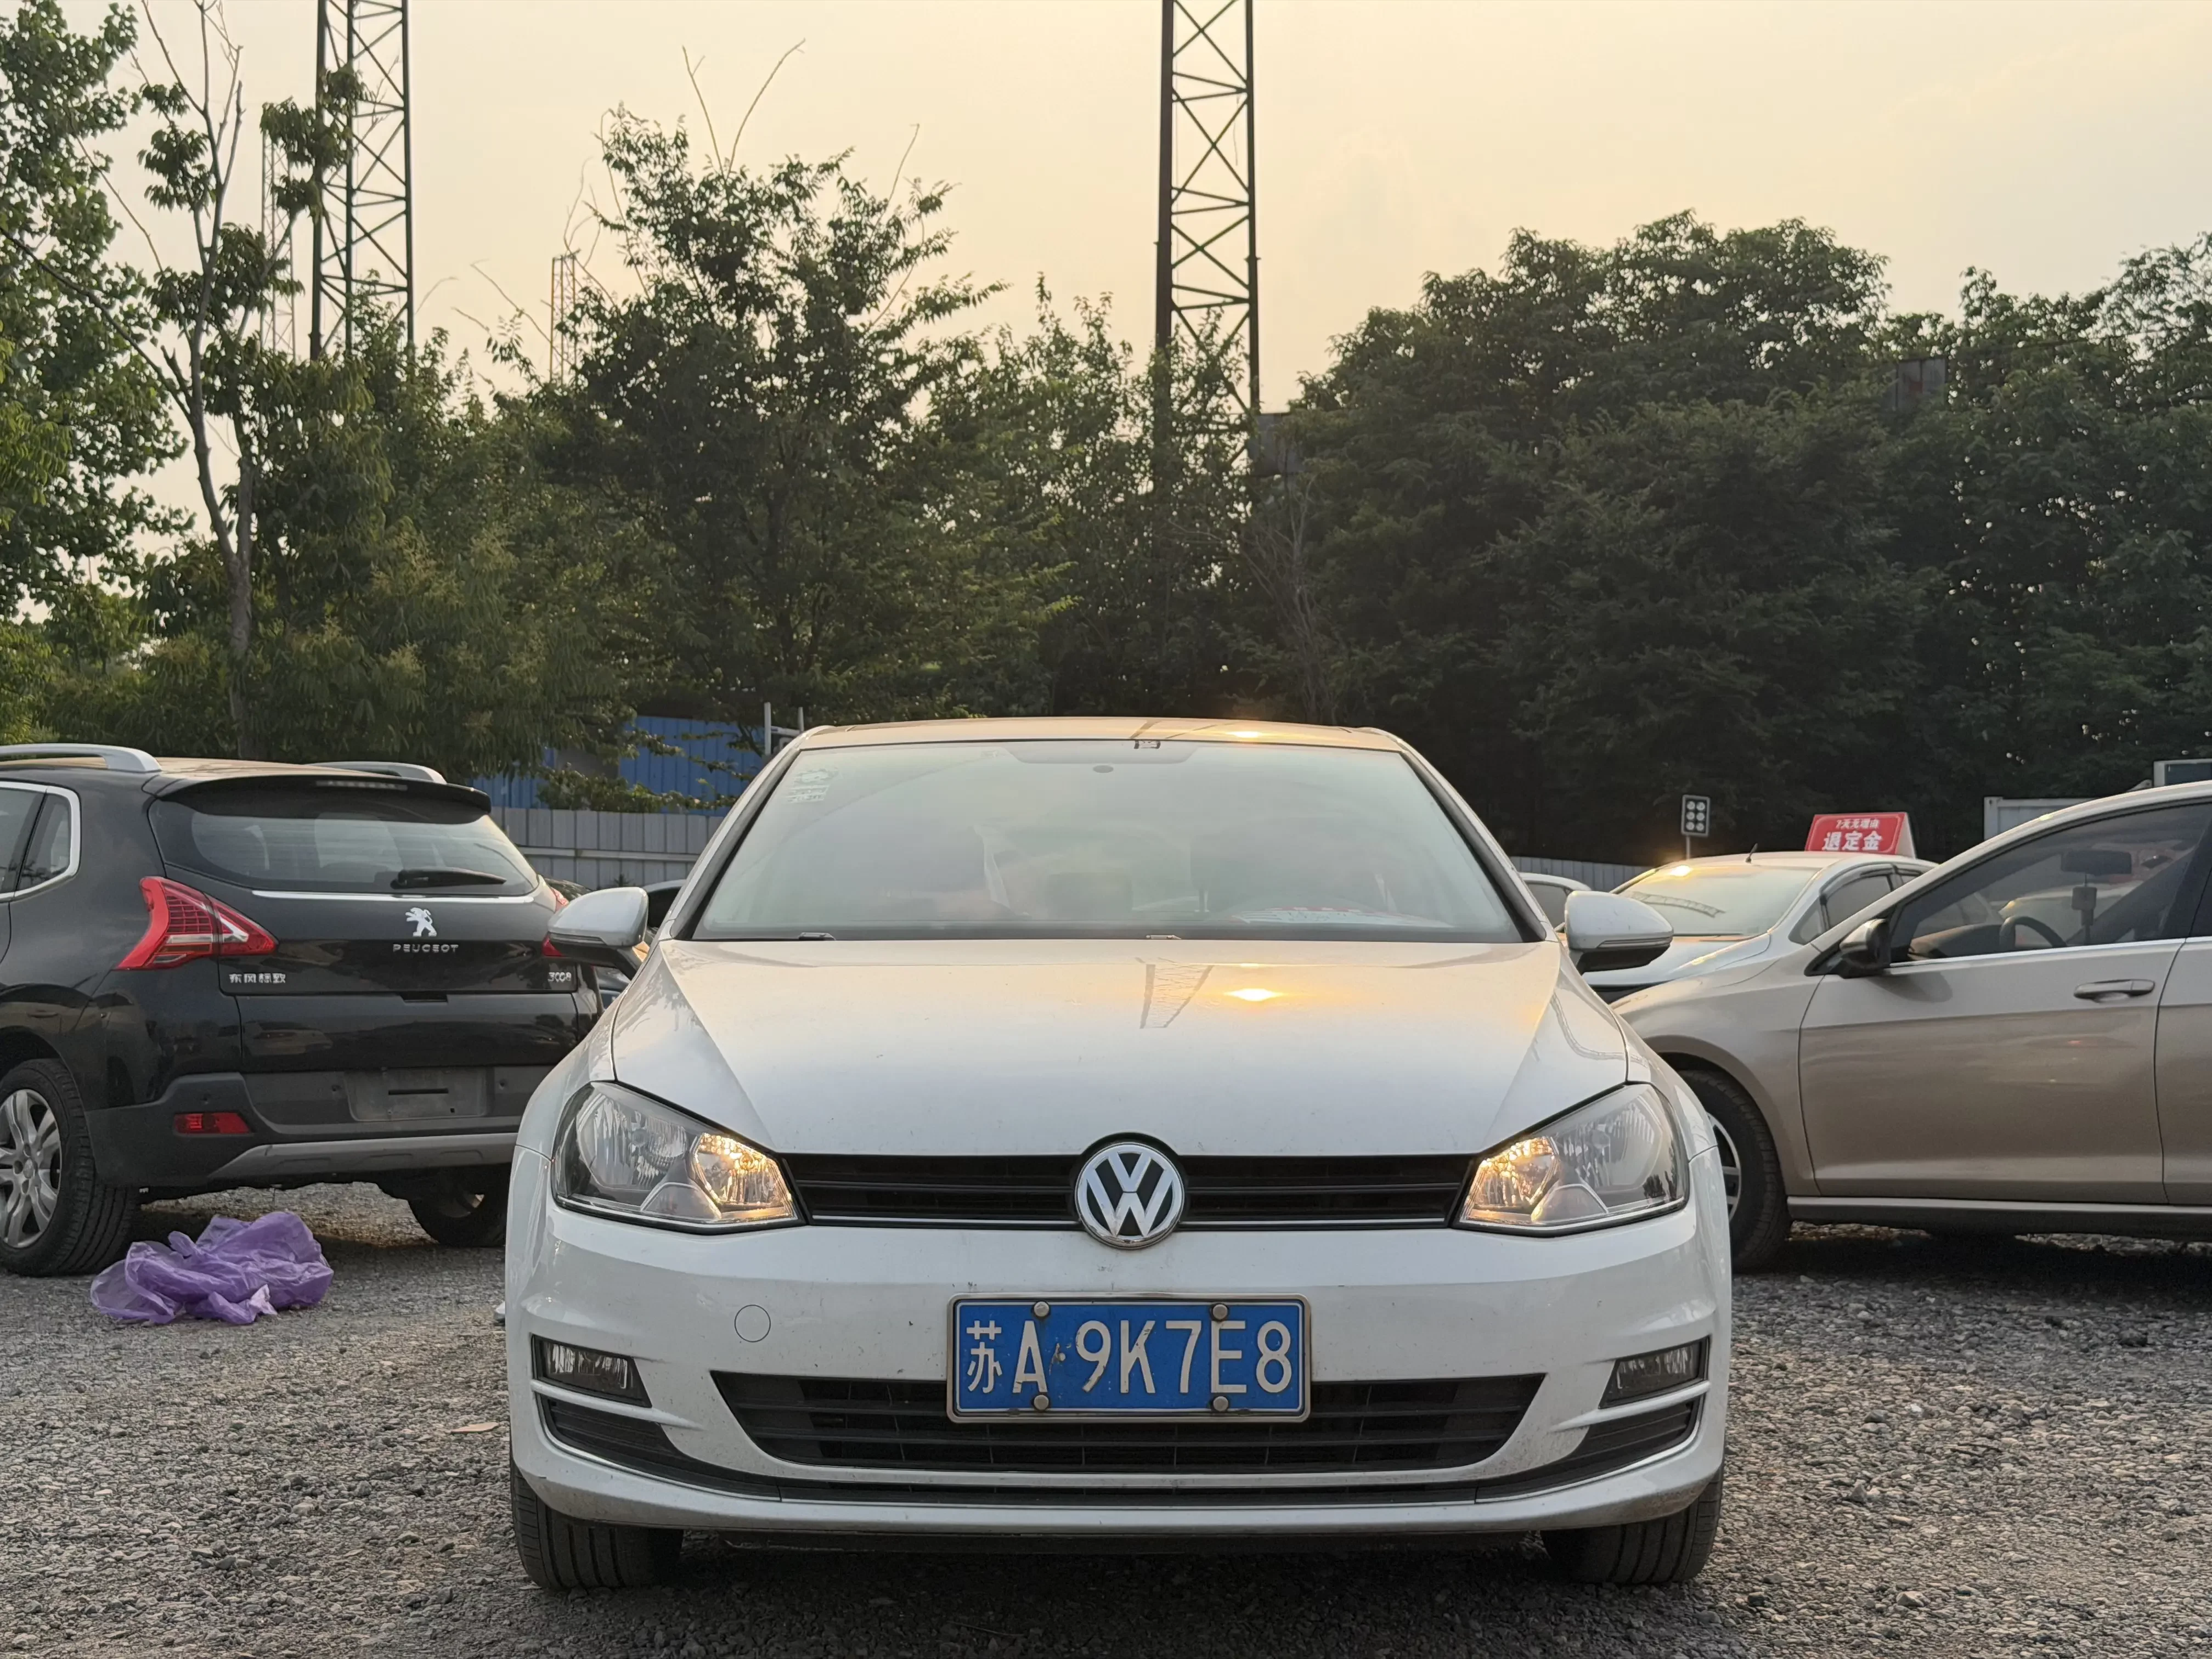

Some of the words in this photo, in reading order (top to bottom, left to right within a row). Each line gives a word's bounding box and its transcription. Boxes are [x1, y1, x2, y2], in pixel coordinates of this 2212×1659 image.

[1822, 831, 1882, 850] 退定金
[393, 944, 459, 952] PEUGEOT
[548, 972, 571, 982] 3008
